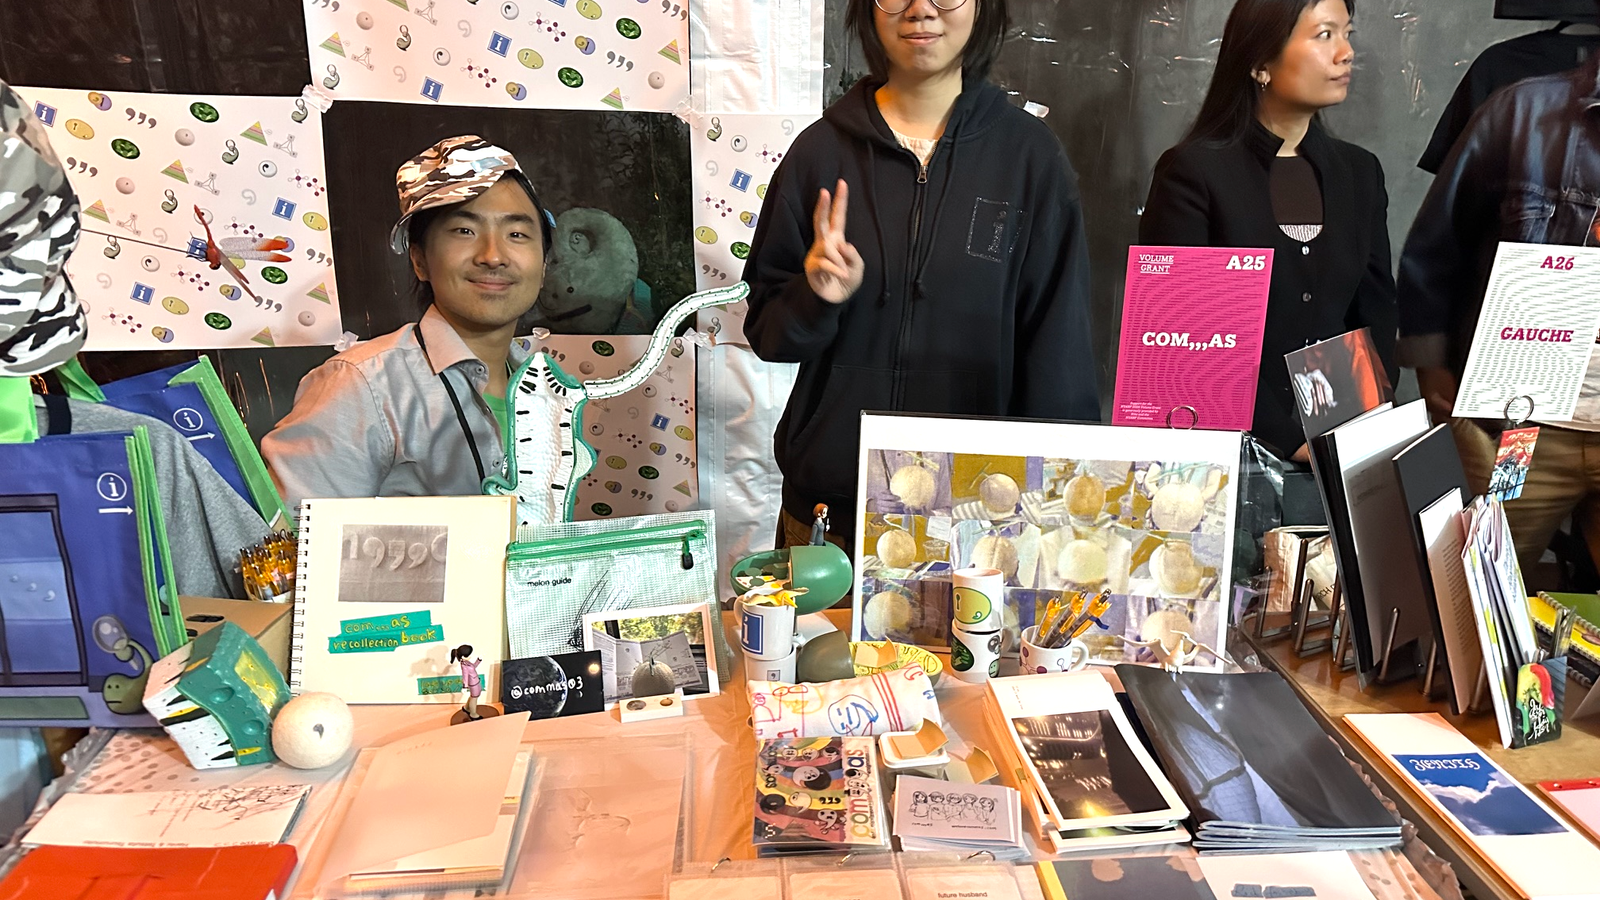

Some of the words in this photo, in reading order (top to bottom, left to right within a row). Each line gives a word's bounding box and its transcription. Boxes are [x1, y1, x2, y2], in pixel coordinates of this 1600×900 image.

[1139, 254, 1174, 263] VOLUME
[1226, 255, 1266, 271] A25
[1540, 255, 1575, 271] A26
[1140, 264, 1171, 273] GRANT
[1142, 331, 1237, 351] COM,,,AS
[1500, 327, 1575, 343] GAUCHE
[527, 579, 550, 587] melon
[552, 577, 572, 586] guide
[333, 637, 399, 650] recollection
[401, 628, 437, 644] book
